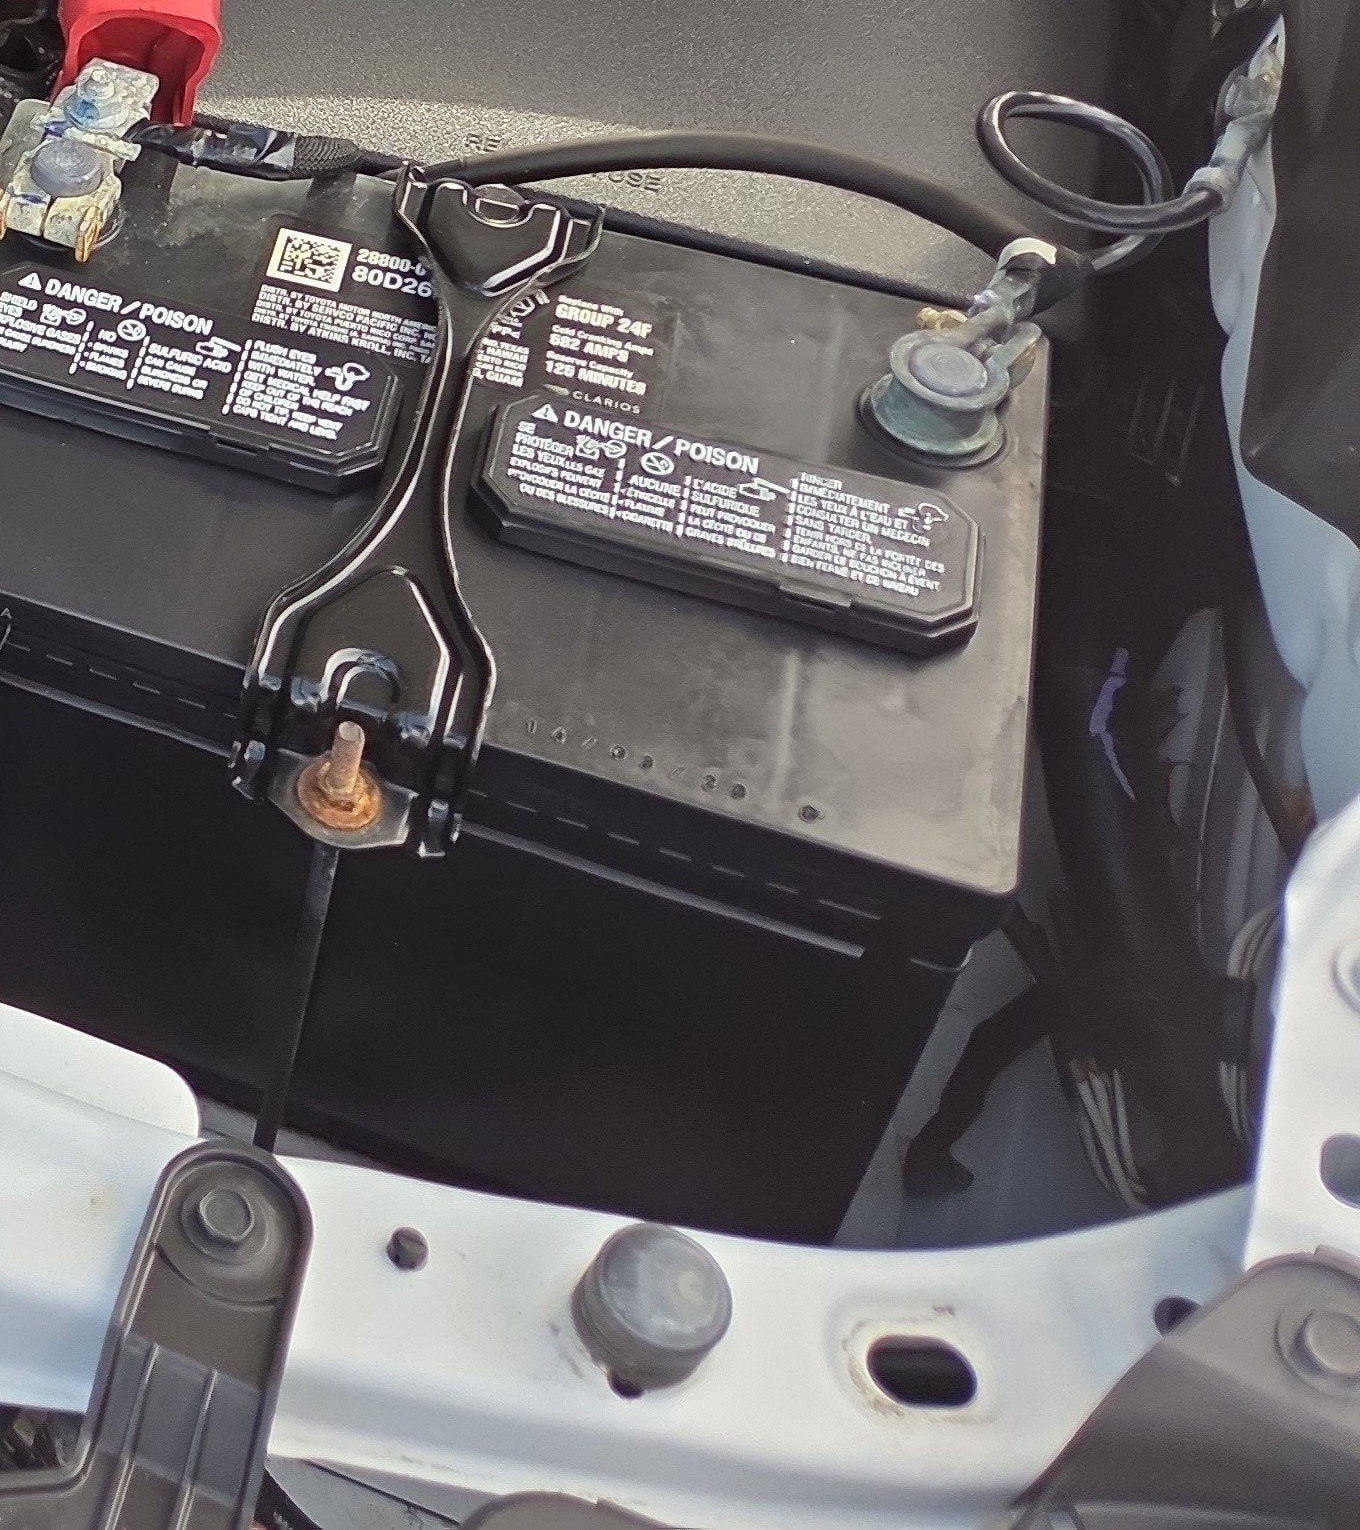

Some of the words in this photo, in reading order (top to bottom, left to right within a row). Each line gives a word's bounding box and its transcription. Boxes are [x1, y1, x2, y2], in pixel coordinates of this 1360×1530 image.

[305, 294, 337, 308] TOYOTA
[299, 309, 333, 324] TOYOTA
[356, 313, 398, 331] PACIFIC
[555, 303, 615, 329] GROUP
[615, 318, 653, 339] 24F
[307, 326, 349, 344] ATKINS
[583, 342, 630, 363] AMPS
[578, 368, 647, 395] MINUTES
[572, 390, 641, 414] CLARIOS
[628, 474, 682, 497] AUCUNE
[693, 478, 738, 499] L'ACIDE
[798, 494, 818, 507] LES
[820, 499, 848, 514] YEUX
[893, 518, 909, 530] ET
